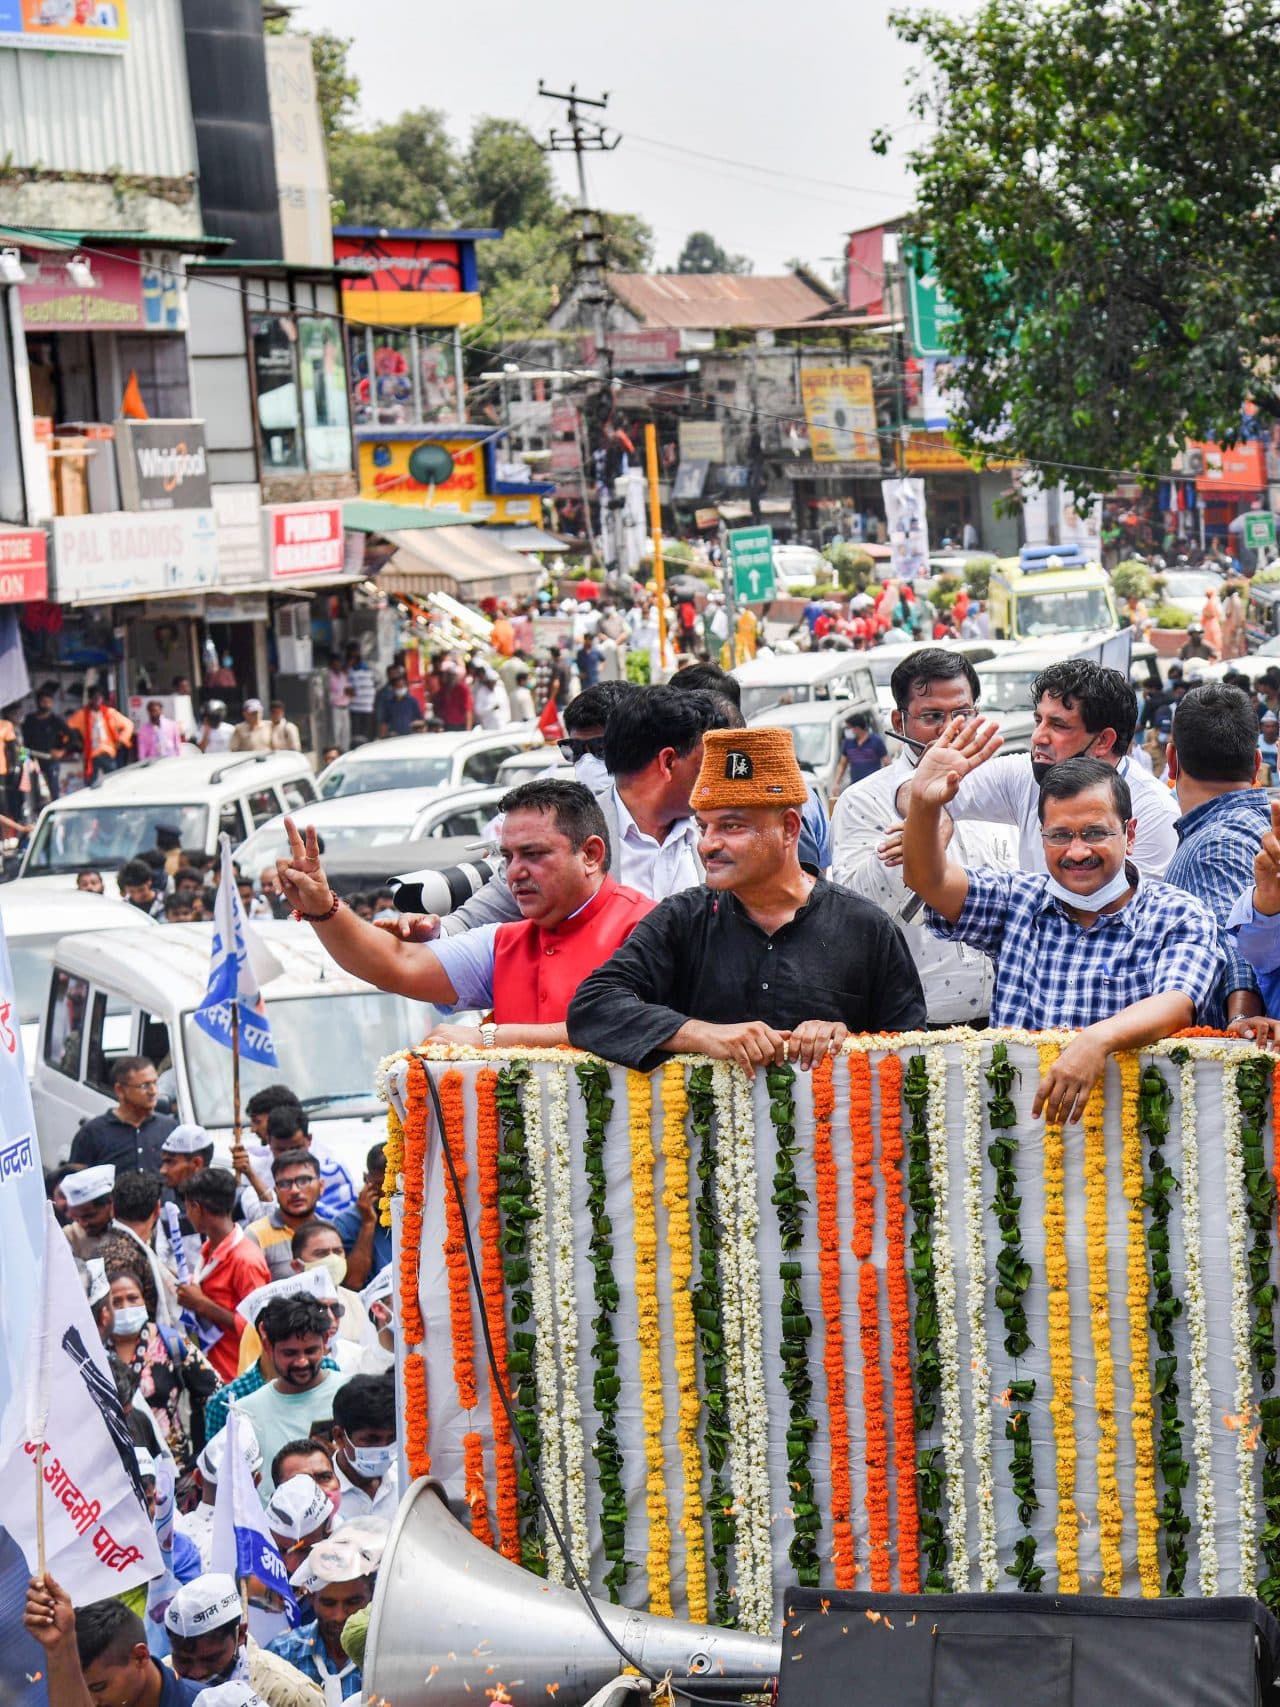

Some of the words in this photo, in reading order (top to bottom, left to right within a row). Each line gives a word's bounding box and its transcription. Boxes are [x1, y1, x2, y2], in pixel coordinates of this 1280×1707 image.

[137, 446, 206, 485] Whirlpool
[63, 529, 104, 565] PAL
[108, 525, 184, 559] RADIOS
[43, 1458, 101, 1536] आदमी
[92, 1525, 144, 1573] पार्टी
[193, 1604, 219, 1623] आम
